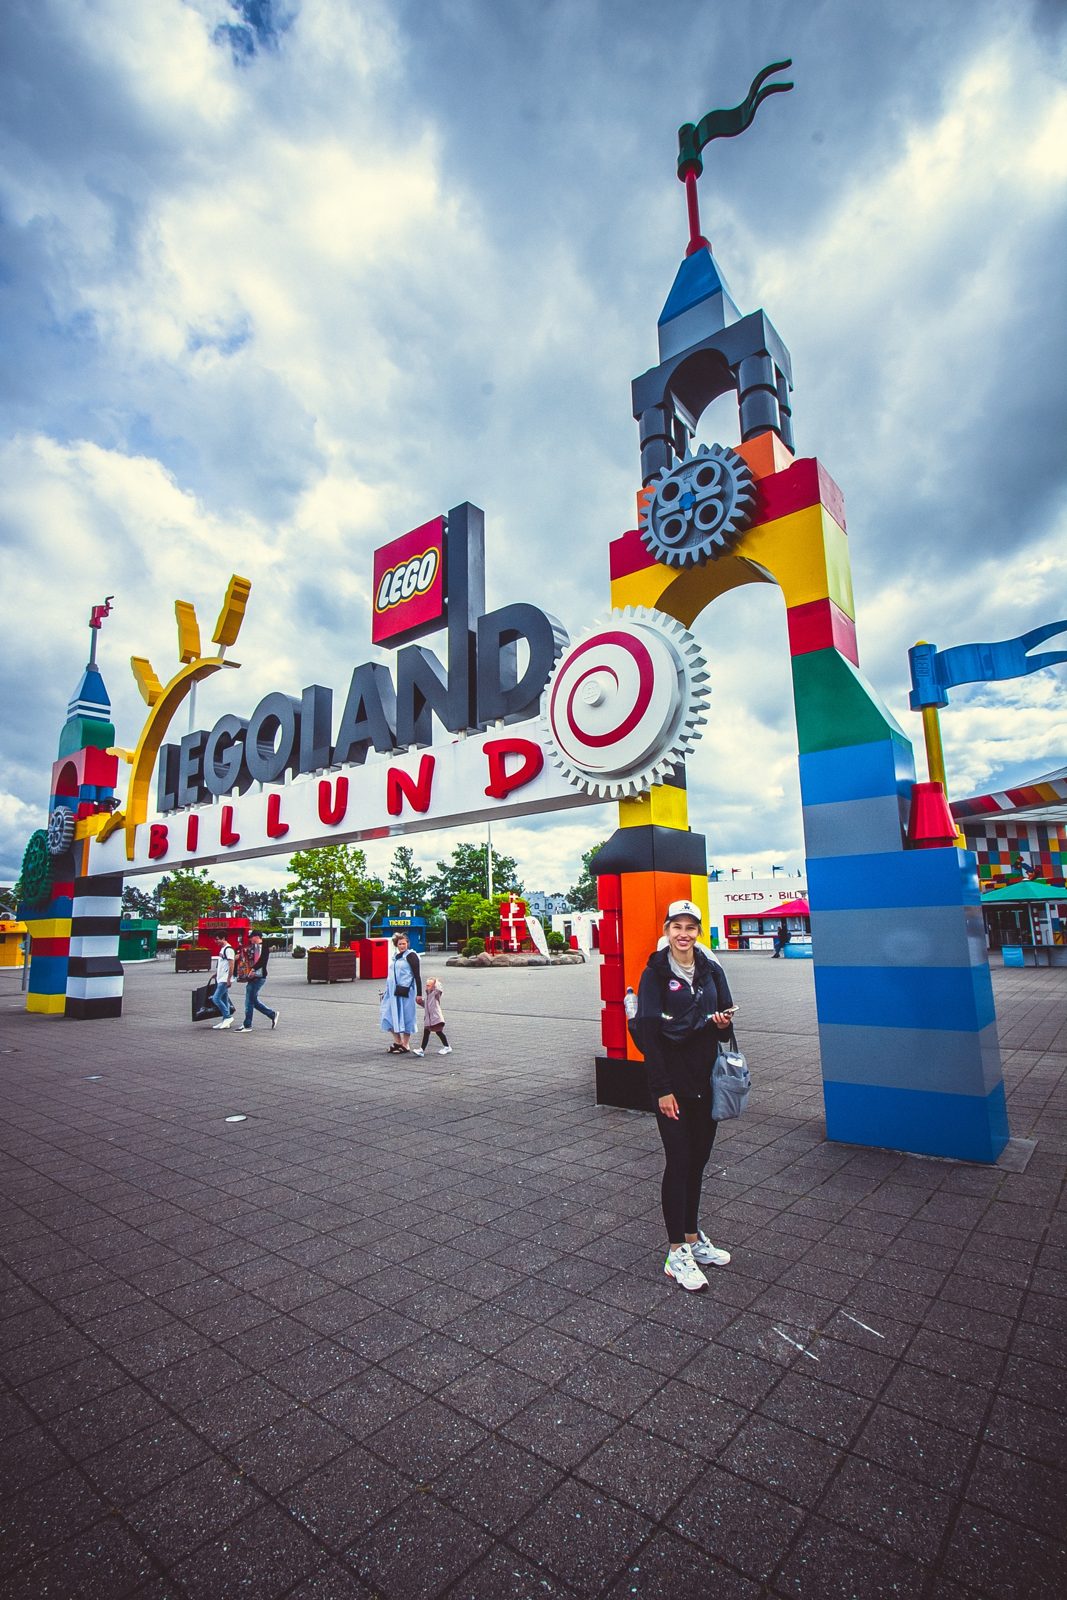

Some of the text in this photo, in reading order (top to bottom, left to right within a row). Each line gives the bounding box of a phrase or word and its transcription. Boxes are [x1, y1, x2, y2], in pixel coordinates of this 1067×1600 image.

[377, 547, 439, 611] LEGO
[157, 501, 566, 812] LEGOLAND
[148, 738, 545, 860] BILLUND
[724, 892, 764, 903] TICKETS
[299, 920, 322, 928] TICKETS
[388, 919, 411, 927] TICKETS
